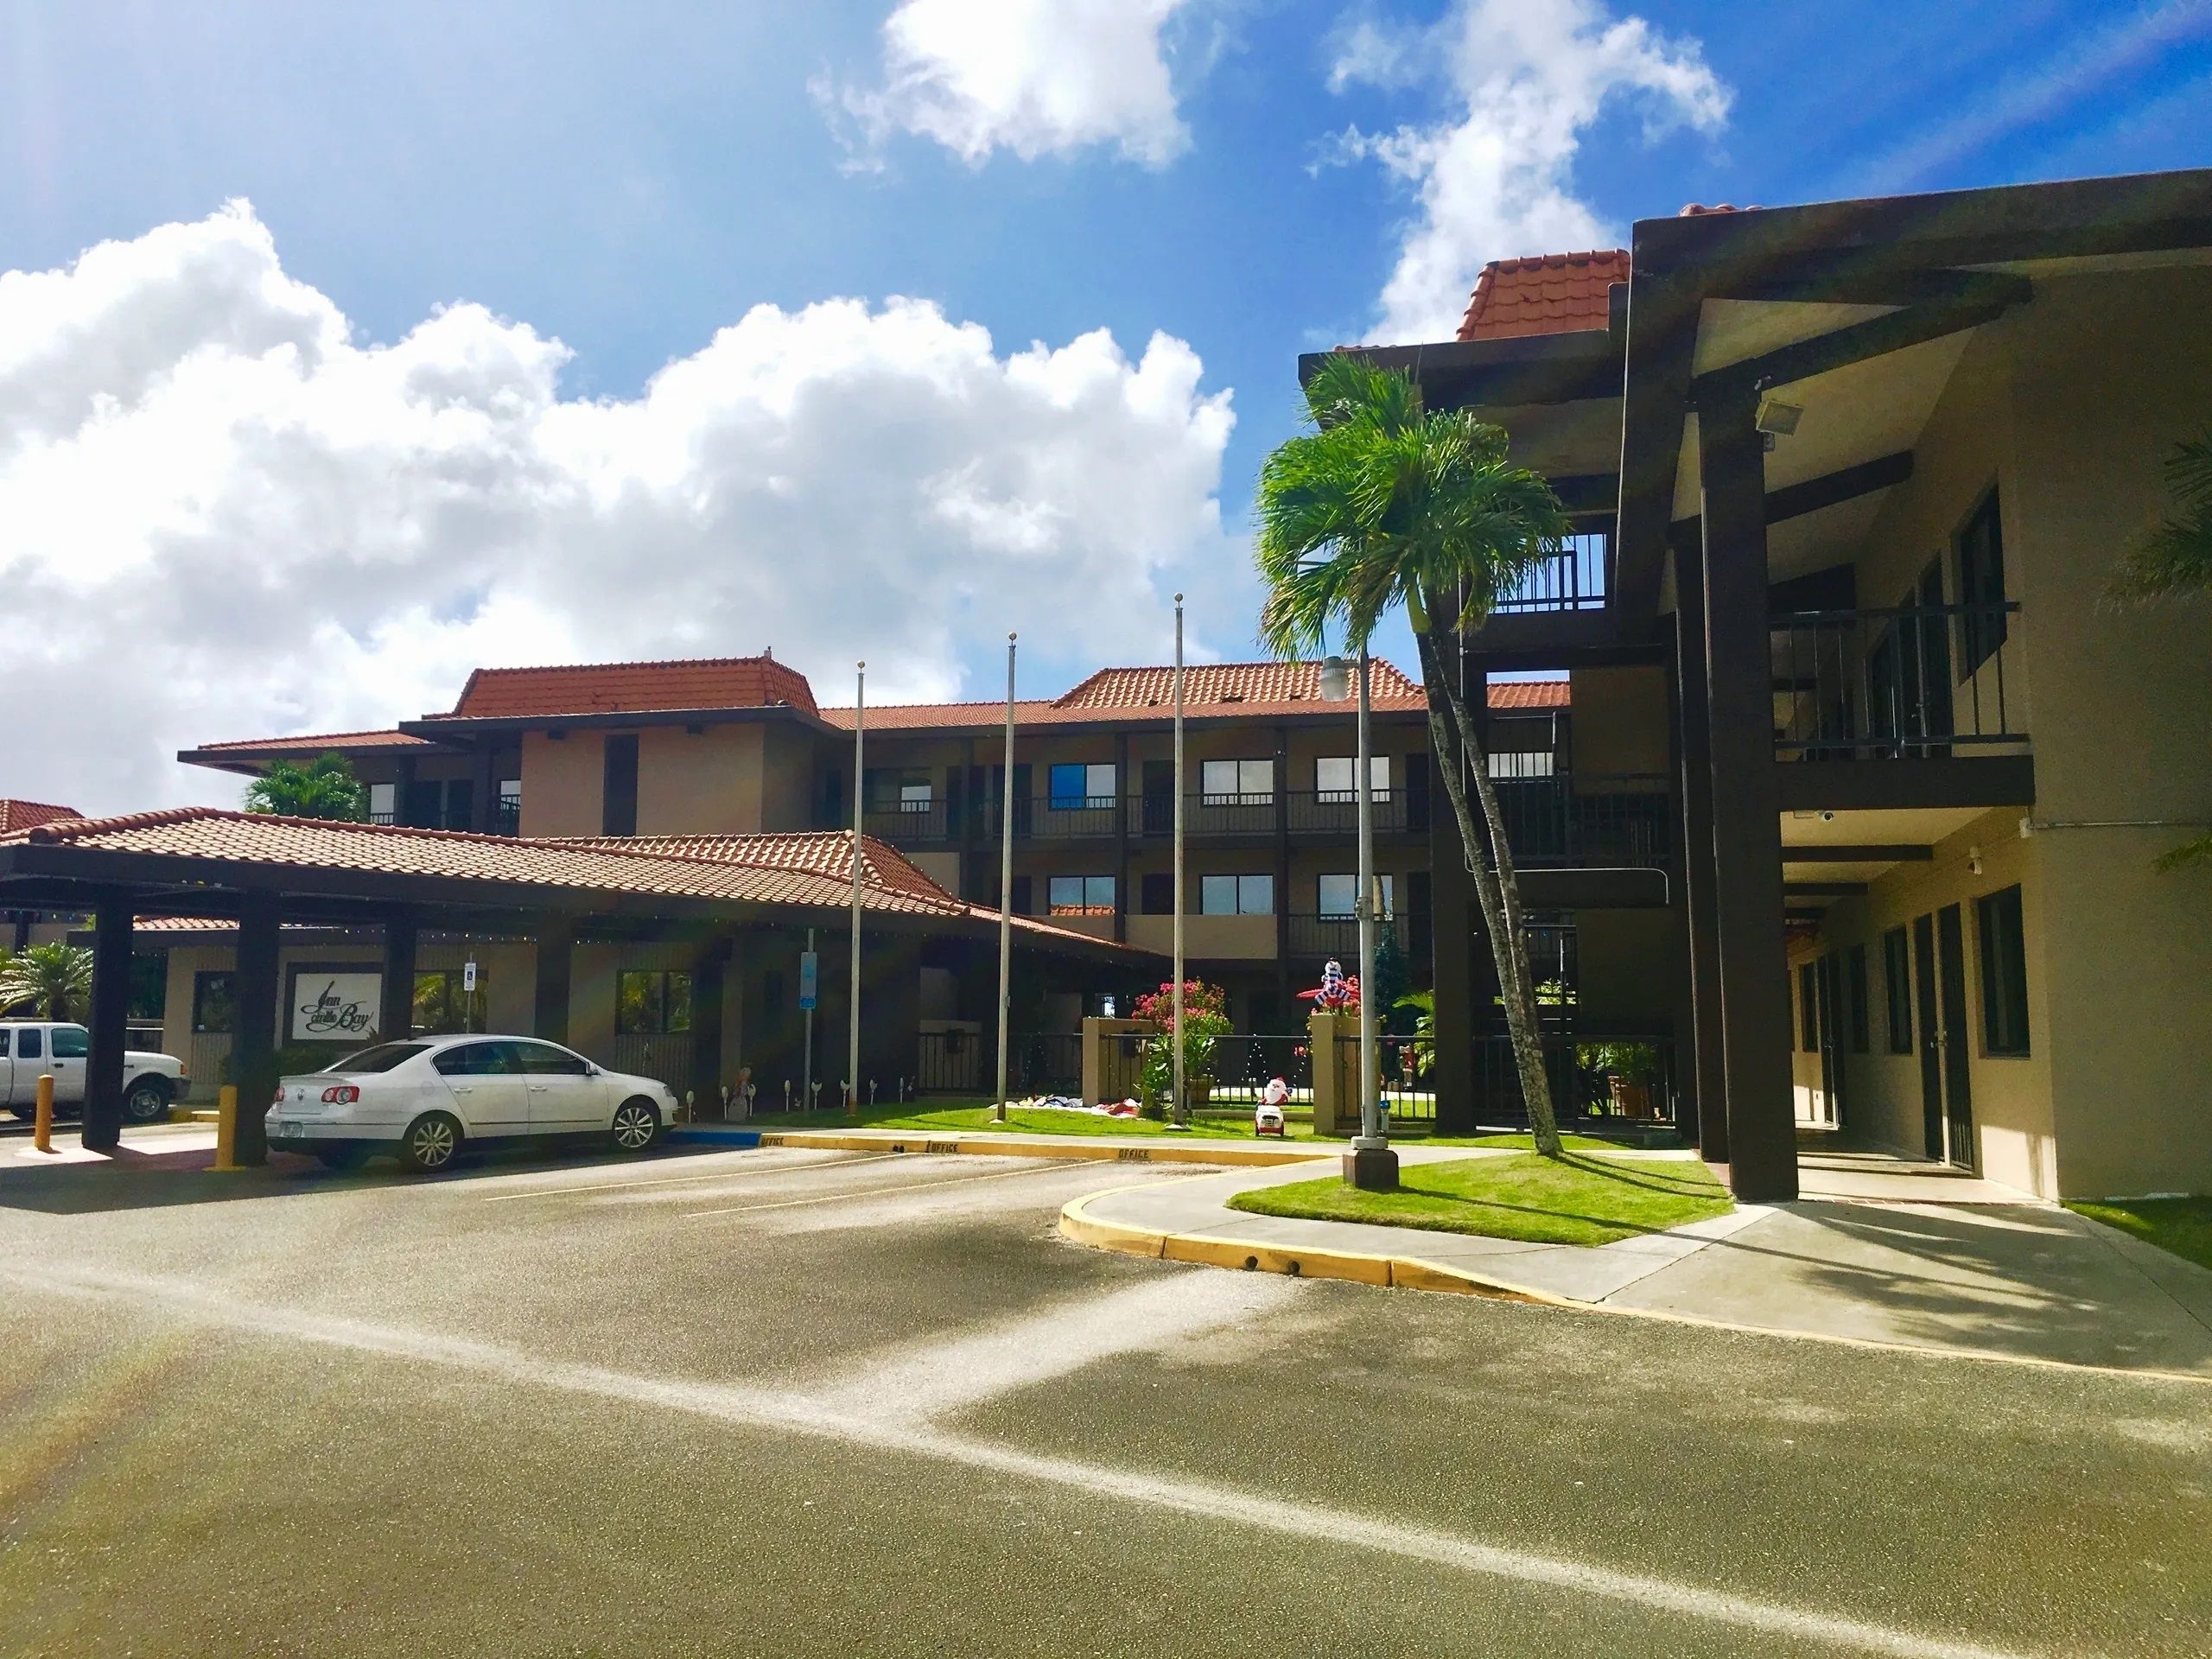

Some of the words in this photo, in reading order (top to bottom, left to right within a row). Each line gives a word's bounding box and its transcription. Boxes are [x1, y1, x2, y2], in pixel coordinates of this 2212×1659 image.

[301, 980, 340, 1014] Inn
[306, 1001, 373, 1032] Bay
[931, 1142, 958, 1153] OFFICE
[1118, 1148, 1149, 1159] OFFICE
